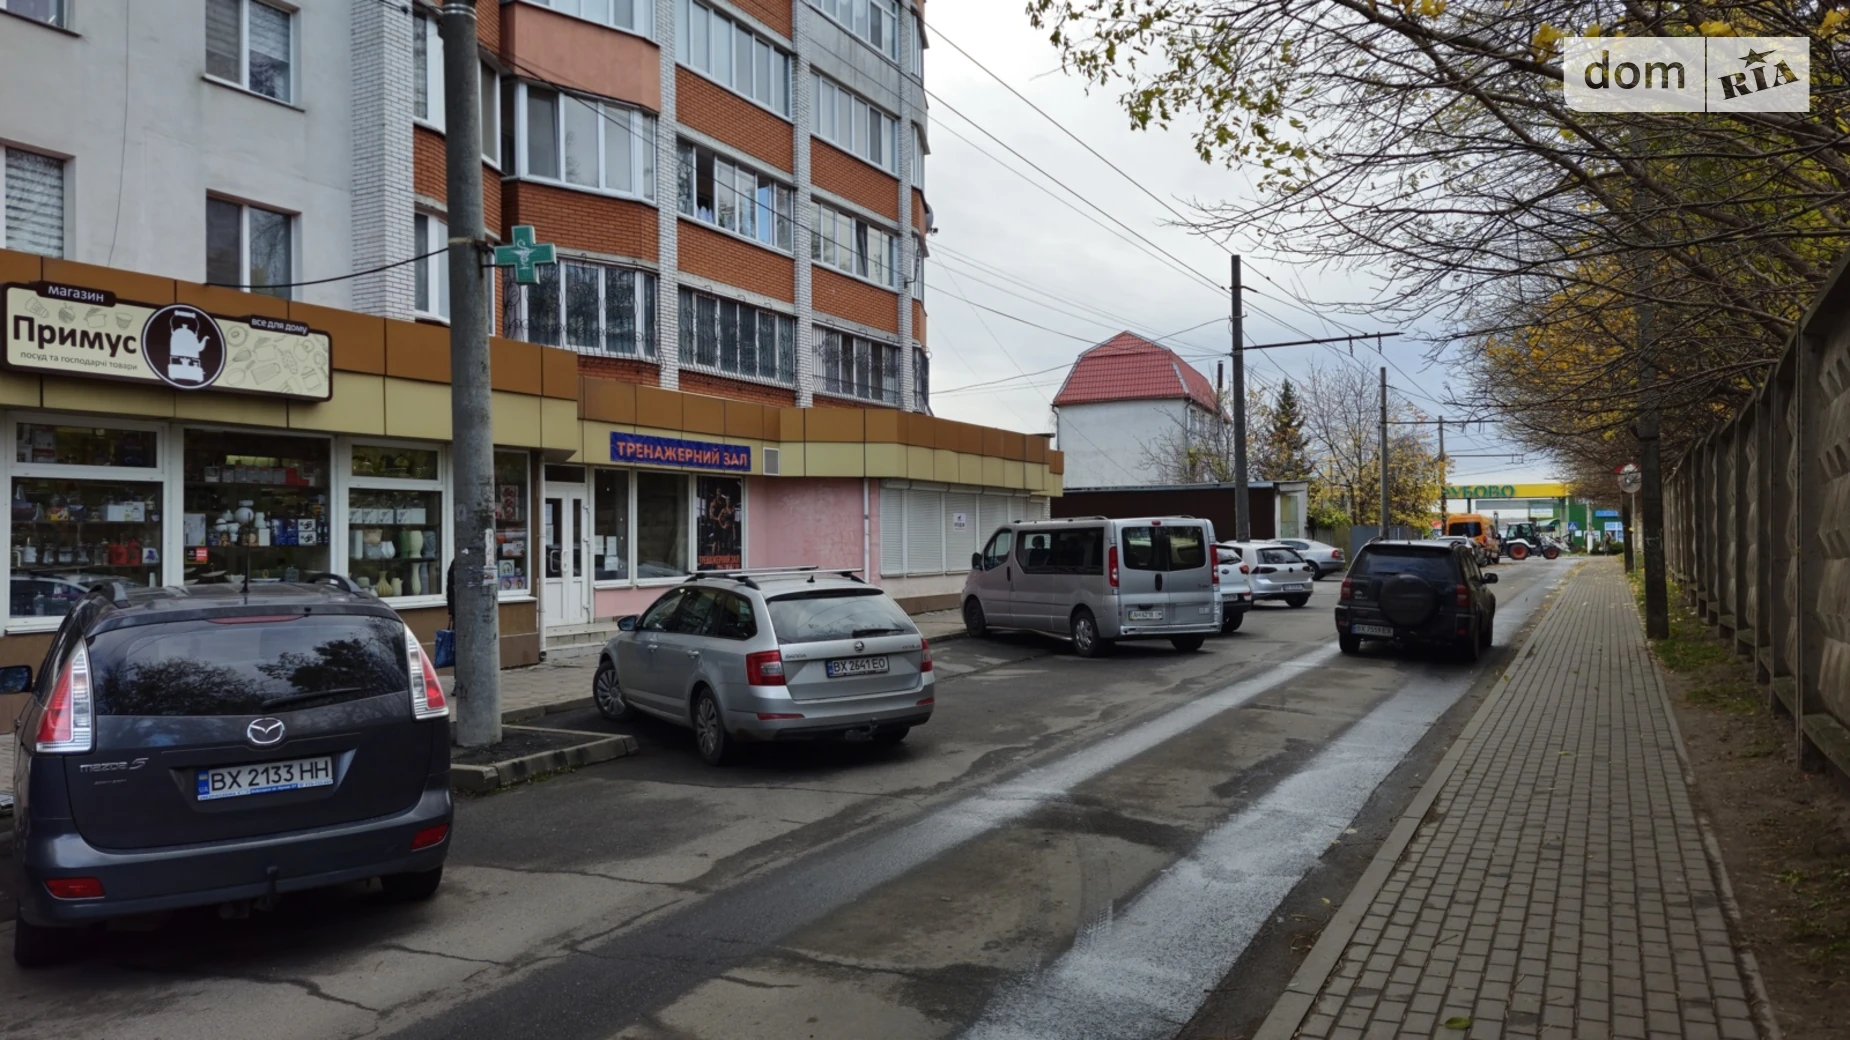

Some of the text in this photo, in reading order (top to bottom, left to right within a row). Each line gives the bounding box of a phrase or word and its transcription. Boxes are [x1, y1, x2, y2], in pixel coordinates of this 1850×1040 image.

[48, 285, 104, 303] магазин
[13, 315, 137, 358] Примус
[251, 318, 308, 335] все для дому
[20, 351, 48, 362] посуд
[60, 356, 107, 368] господарчі
[109, 361, 138, 371] товари
[617, 441, 747, 467] ТРЕНАЖЕРНИЙ ЗАЛ
[834, 660, 848, 673] BX
[849, 659, 871, 671] 2641
[210, 770, 243, 792] BX
[247, 763, 295, 787] 2133
[299, 759, 329, 781] HH
